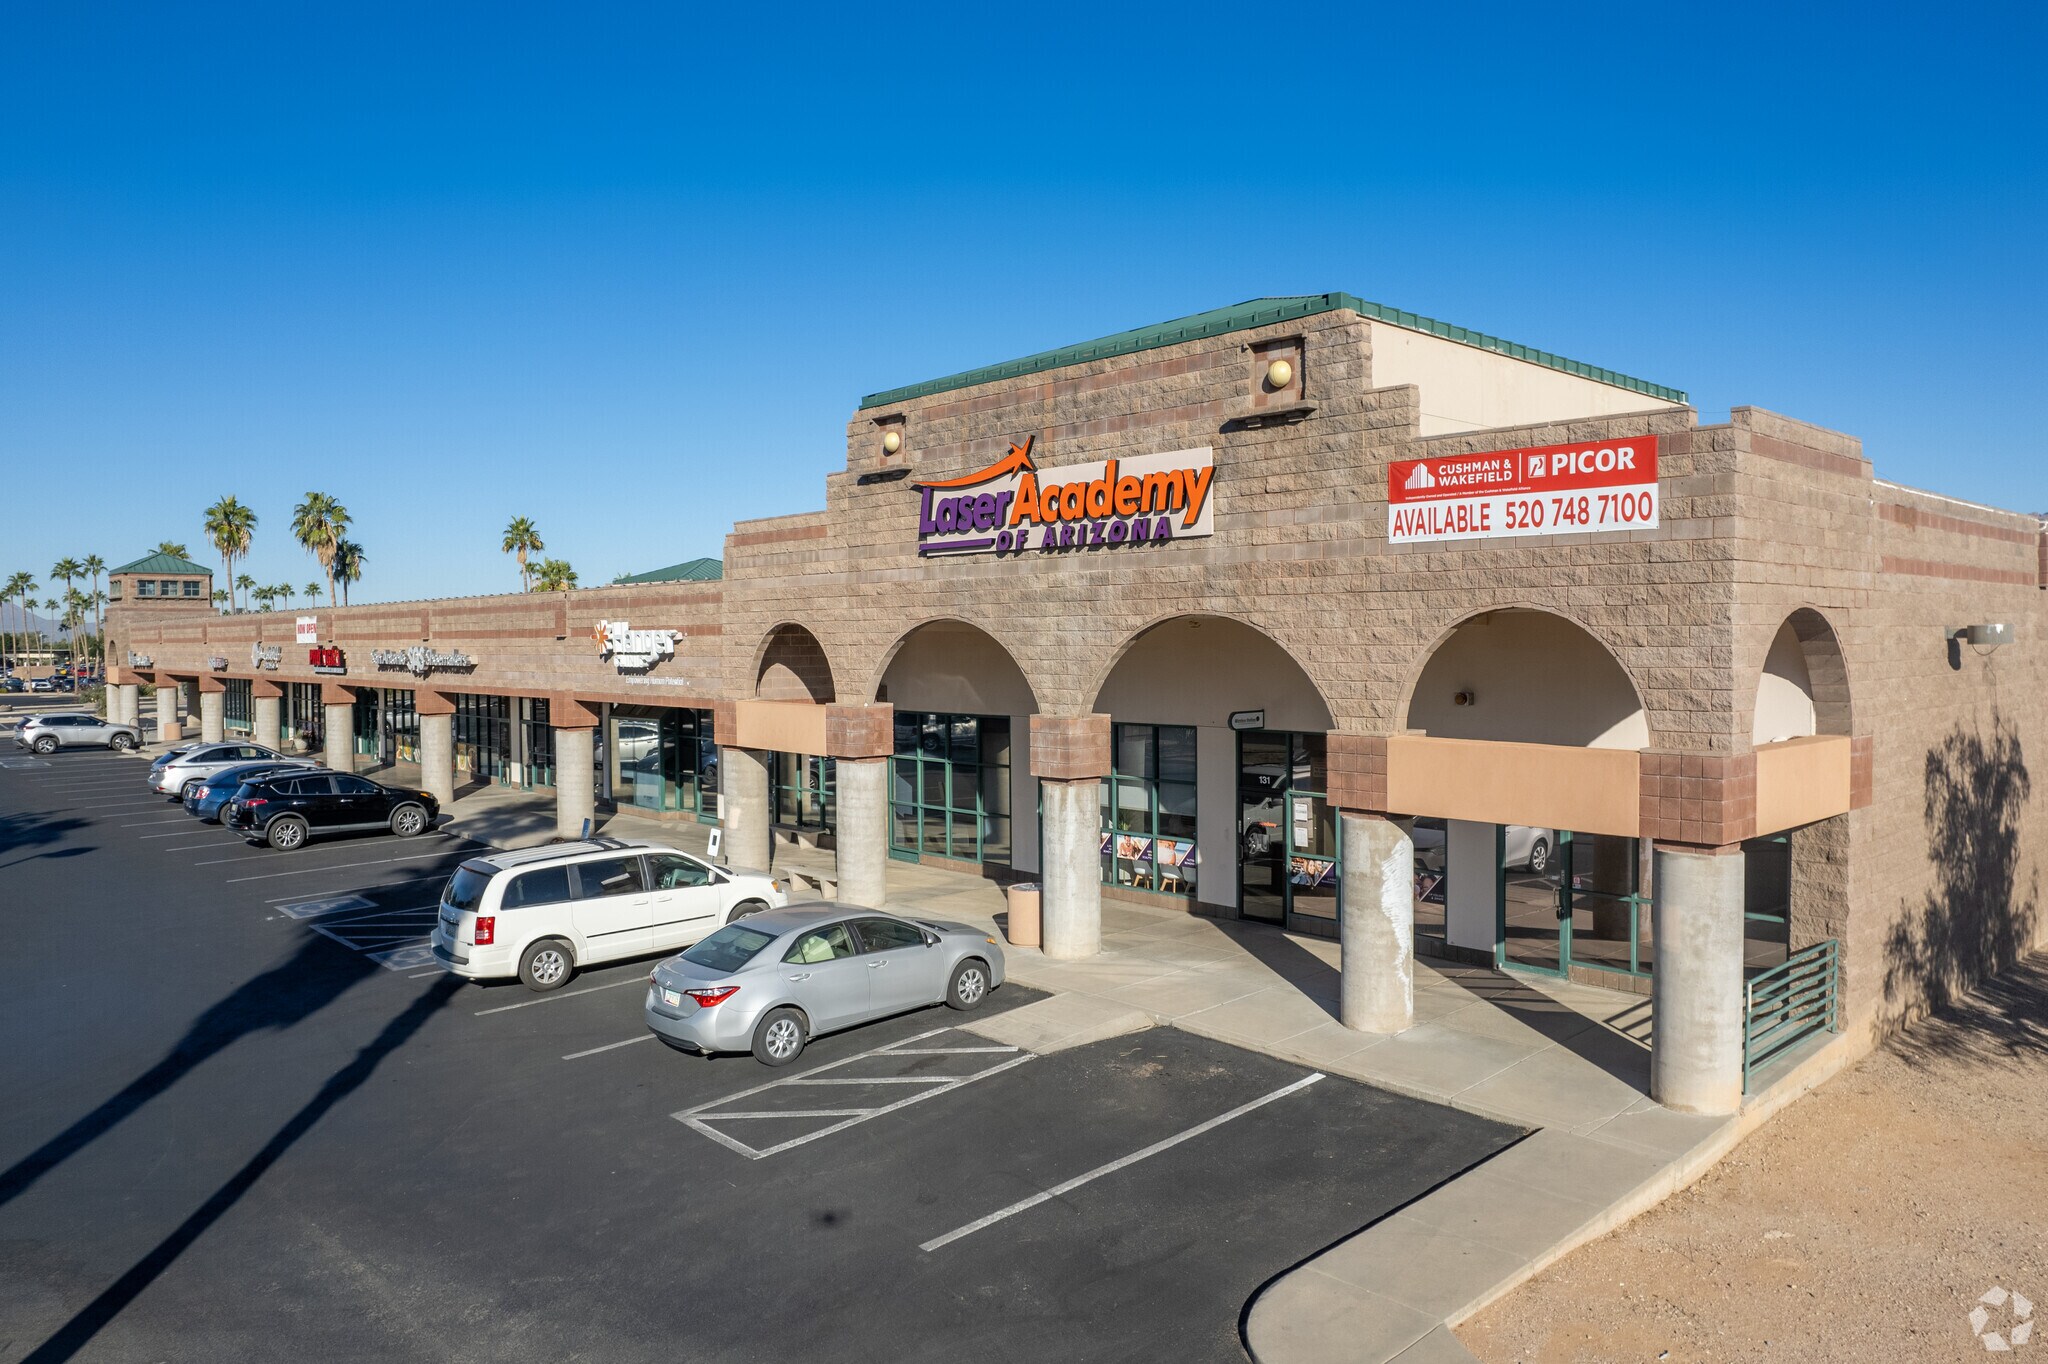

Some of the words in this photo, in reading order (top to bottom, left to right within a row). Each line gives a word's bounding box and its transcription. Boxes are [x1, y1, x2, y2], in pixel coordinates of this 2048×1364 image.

[1439, 460, 1500, 475] CUSHMAN
[1503, 458, 1512, 469] &
[1552, 446, 1636, 476] PICOR
[1439, 471, 1513, 487] WAKEFIELD
[919, 487, 1012, 534] Laser
[1009, 460, 1214, 525] Academy
[1392, 503, 1491, 537] AVAILABLE
[1505, 499, 1544, 529] 520
[1552, 496, 1590, 527] 748
[1598, 491, 1653, 524] 7100
[996, 530, 1028, 550] OF
[1042, 517, 1171, 548] ARIZONA
[307, 623, 317, 634] OPEN
[613, 621, 677, 664] Hanger
[1259, 775, 1271, 785] 131
